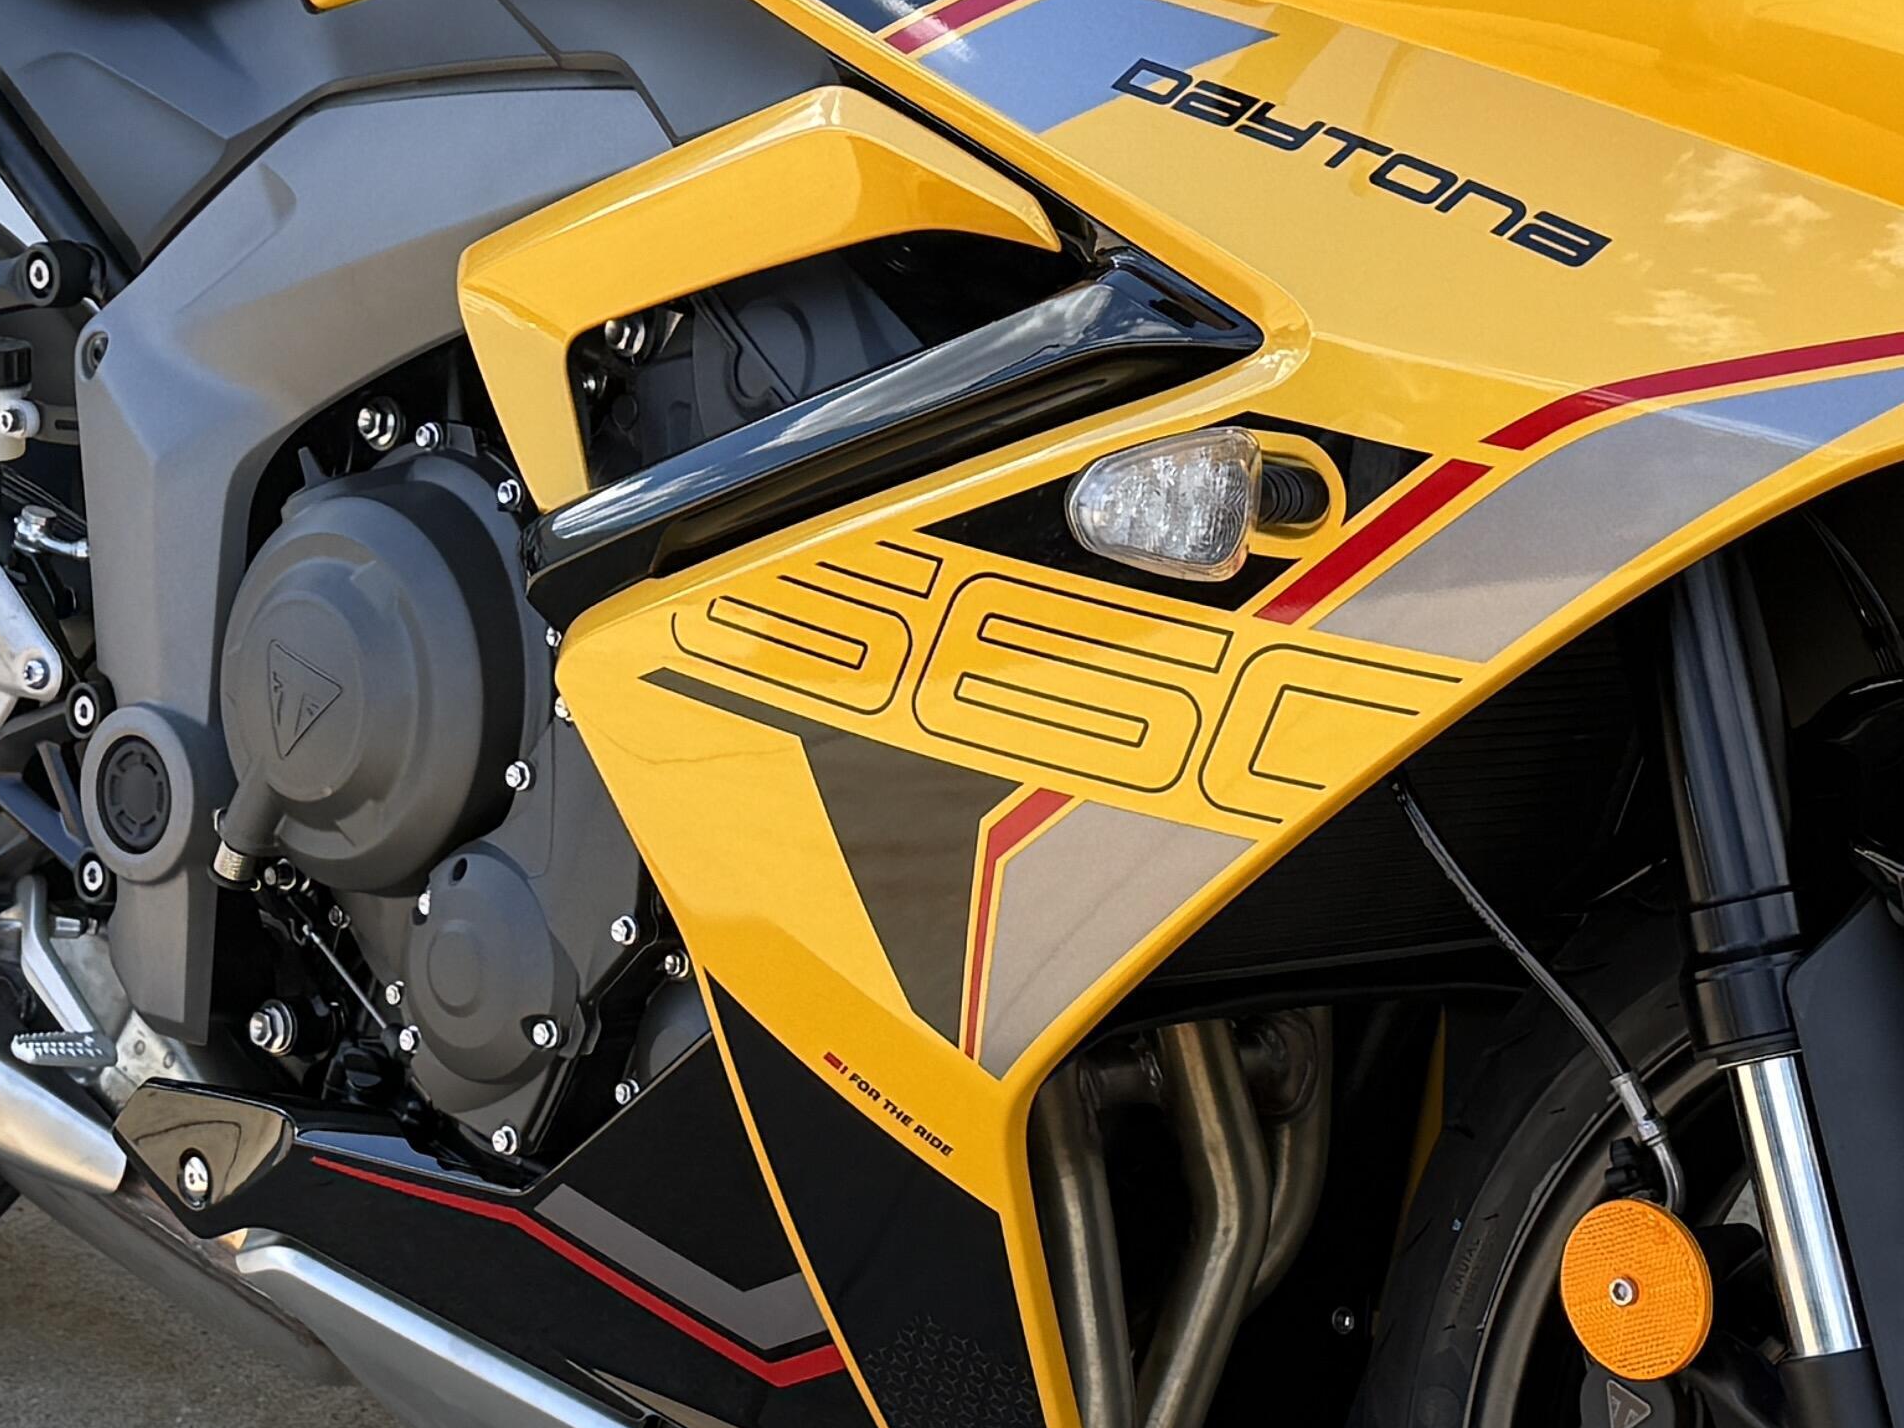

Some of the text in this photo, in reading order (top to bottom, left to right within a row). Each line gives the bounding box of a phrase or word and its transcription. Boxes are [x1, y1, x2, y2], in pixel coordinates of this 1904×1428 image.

[848, 1072, 954, 1157] FOR THE RIDE
